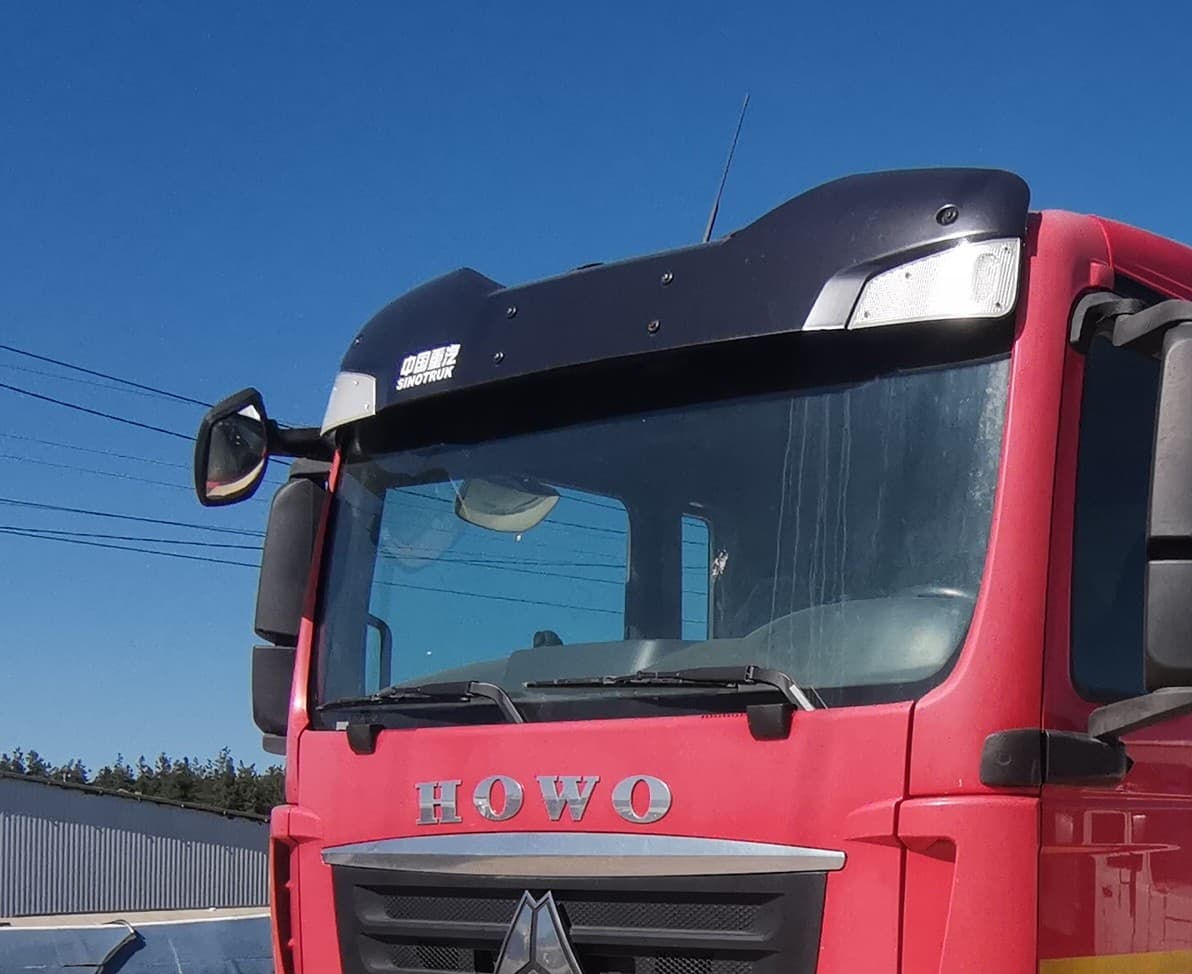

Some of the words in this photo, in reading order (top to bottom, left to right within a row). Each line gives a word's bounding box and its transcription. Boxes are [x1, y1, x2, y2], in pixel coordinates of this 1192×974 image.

[399, 343, 461, 377] 中国重汽
[395, 365, 455, 391] SINOTRUK
[415, 774, 673, 826] HOWO
